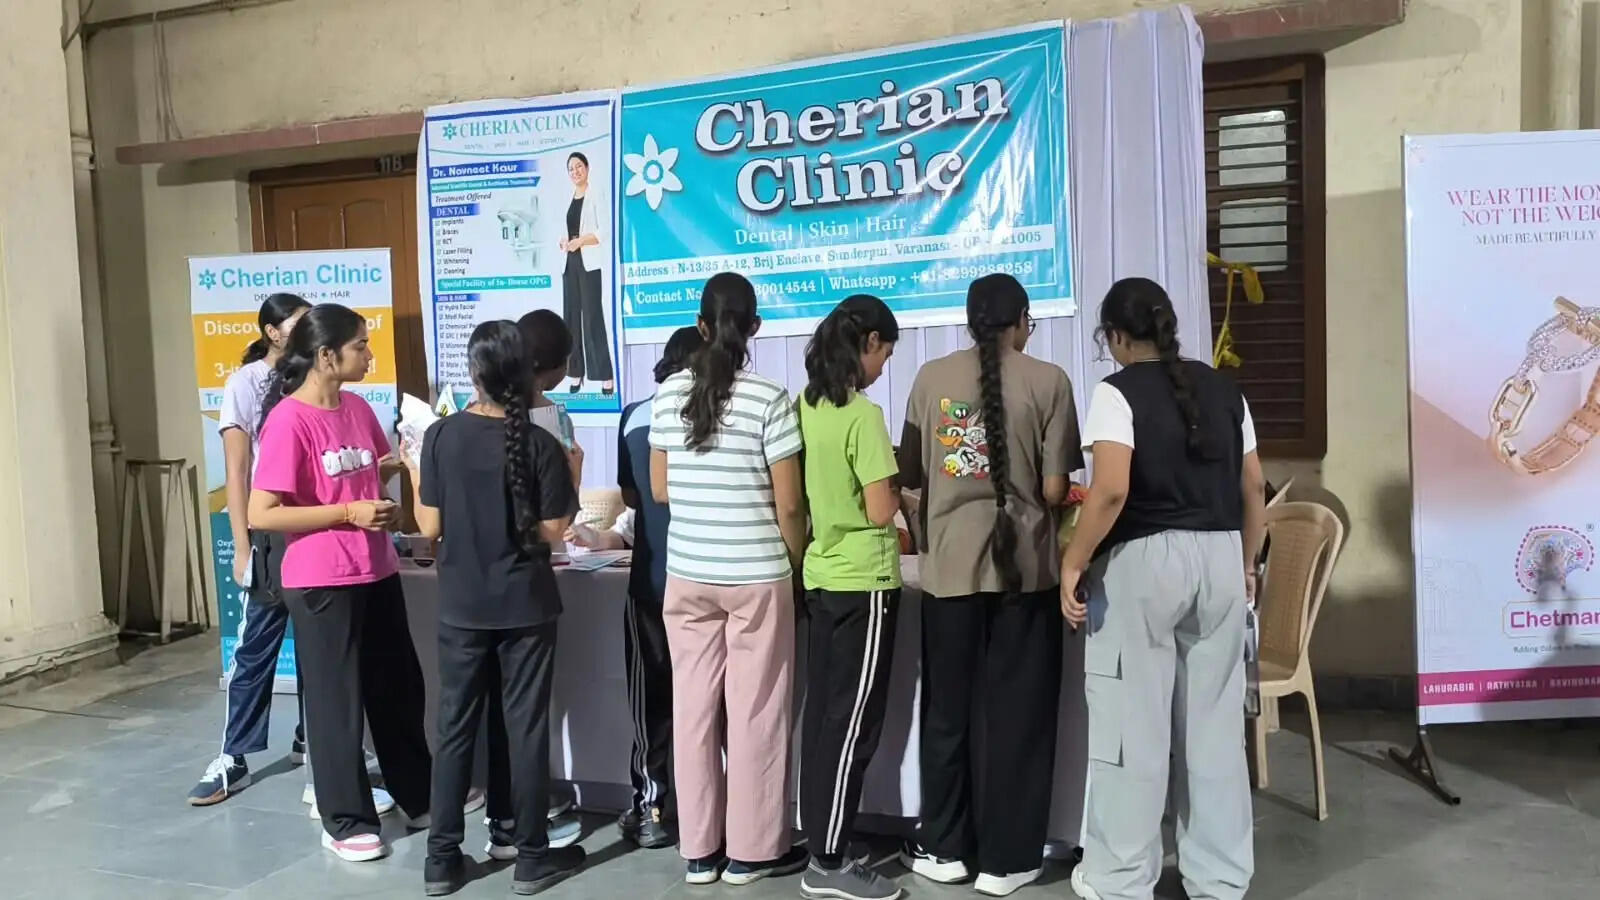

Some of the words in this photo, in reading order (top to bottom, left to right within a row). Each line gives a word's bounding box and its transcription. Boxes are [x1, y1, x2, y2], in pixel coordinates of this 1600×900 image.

[694, 78, 1010, 153] Cherian
[460, 118, 533, 138] CHERIAN
[535, 112, 589, 131] CLINIC
[433, 168, 446, 178] Dr.
[492, 164, 518, 173] Kaur
[736, 141, 964, 213] Clinic
[435, 195, 465, 203] Treatment
[466, 192, 492, 202] Offered
[1447, 188, 1511, 206] WEAR
[1515, 186, 1556, 204] THE
[436, 206, 470, 217] DENTAL
[1461, 208, 1504, 226] NOT
[1508, 207, 1550, 224] THE
[735, 224, 792, 245] Dental
[808, 220, 849, 238] Skin
[866, 215, 907, 232] Hair
[1475, 234, 1513, 245] MADE
[1515, 230, 1596, 243] BEAUTIFULLY
[221, 265, 308, 288] Cherian
[316, 262, 382, 284] Clinic
[627, 266, 669, 278] Address
[678, 261, 719, 274] N-13/35
[754, 255, 774, 270] Brij
[462, 280, 486, 290] Facility
[529, 277, 548, 286] OPG
[829, 273, 897, 290] Whatsapp
[330, 289, 351, 299] HAIR
[636, 289, 683, 304] Contact
[366, 314, 382, 330] of
